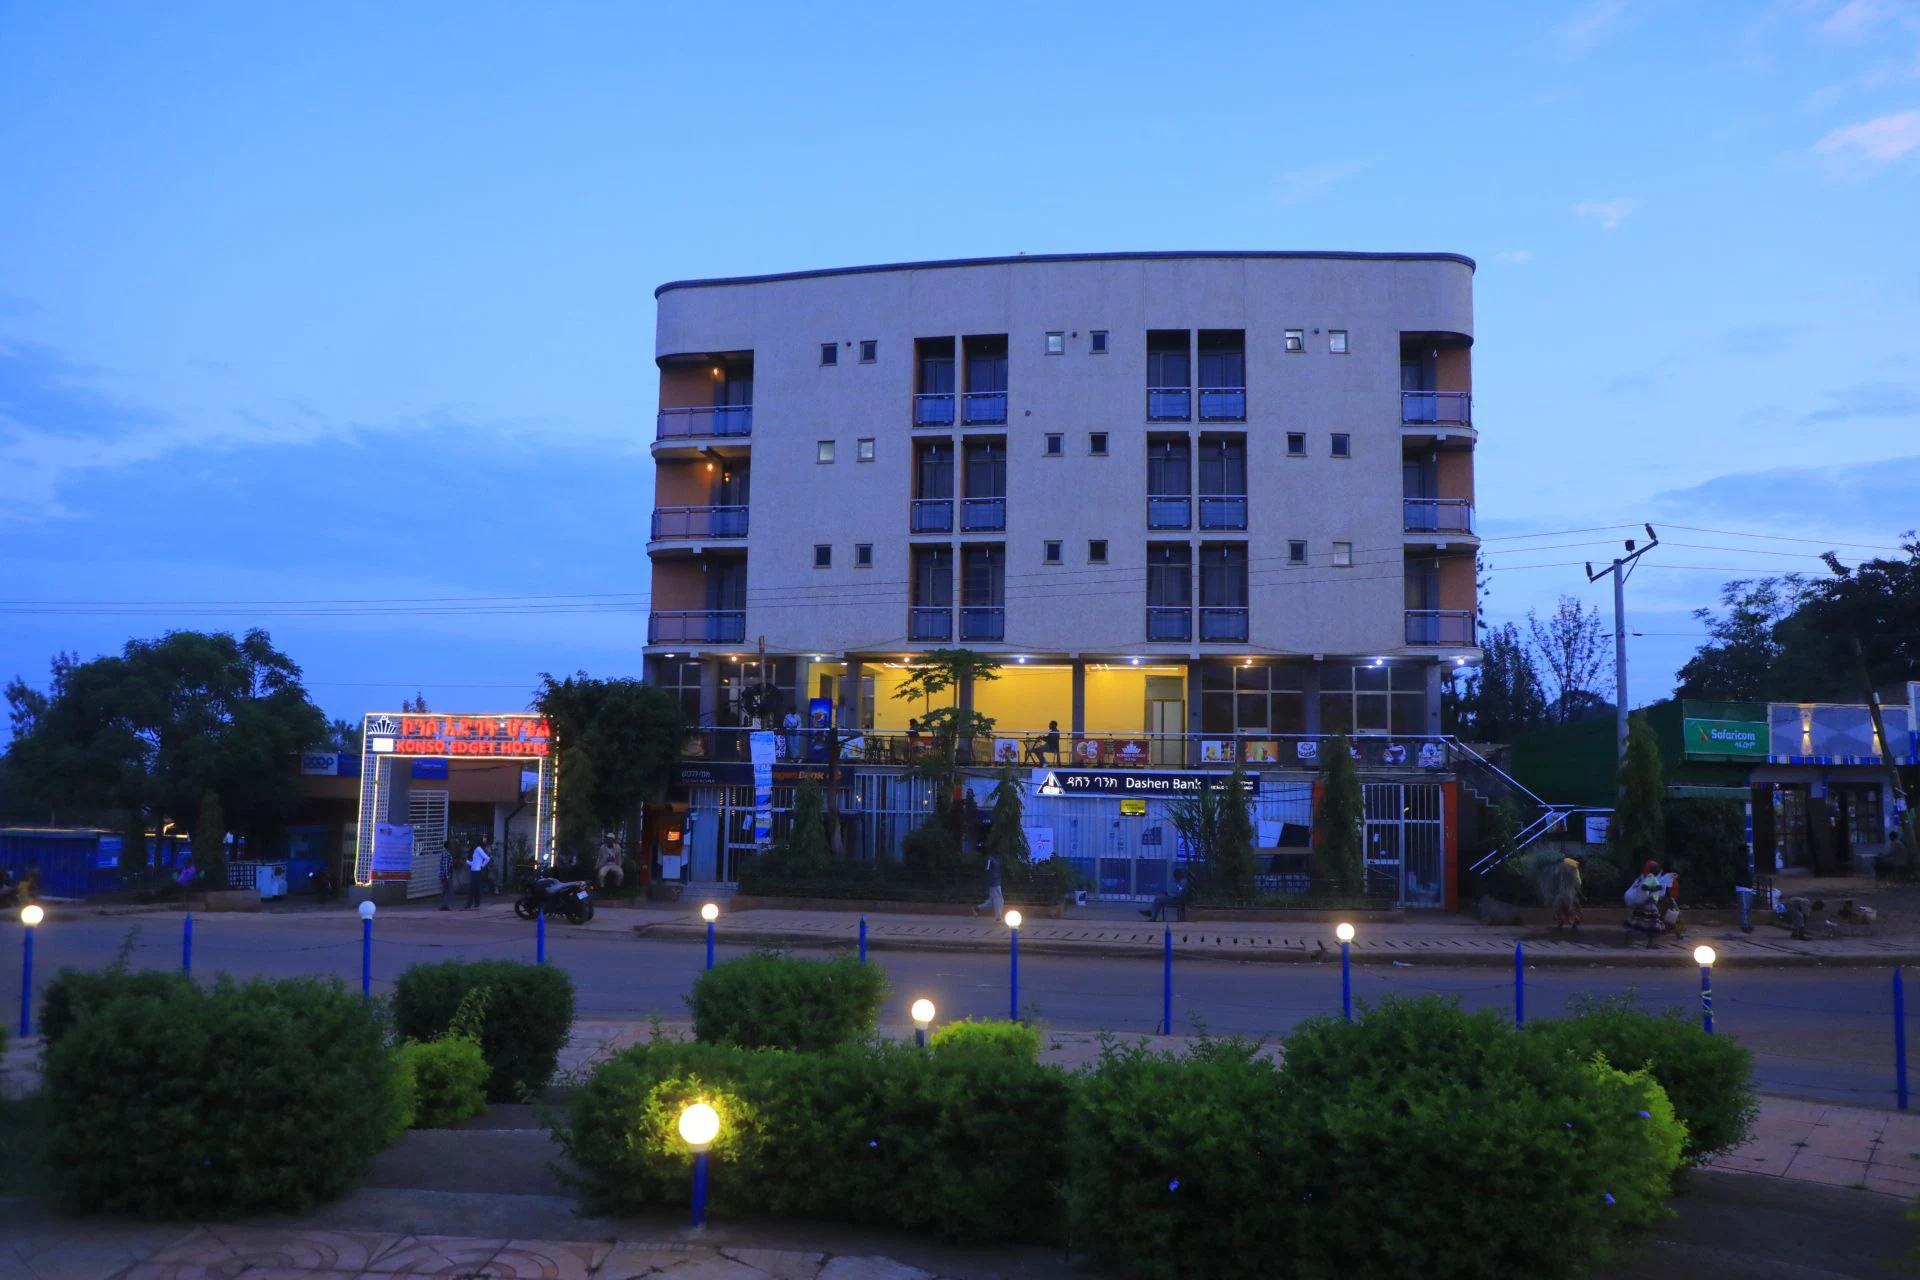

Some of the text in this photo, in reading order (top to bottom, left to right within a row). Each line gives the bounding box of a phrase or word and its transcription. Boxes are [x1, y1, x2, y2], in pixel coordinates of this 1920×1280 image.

[1711, 729, 1756, 741] Safaricom
[396, 740, 550, 755] KONSO EDGET HOTEL
[1094, 776, 1118, 788] ባንክ
[1126, 777, 1169, 789] Dashen
[1173, 777, 1202, 790] Bank
